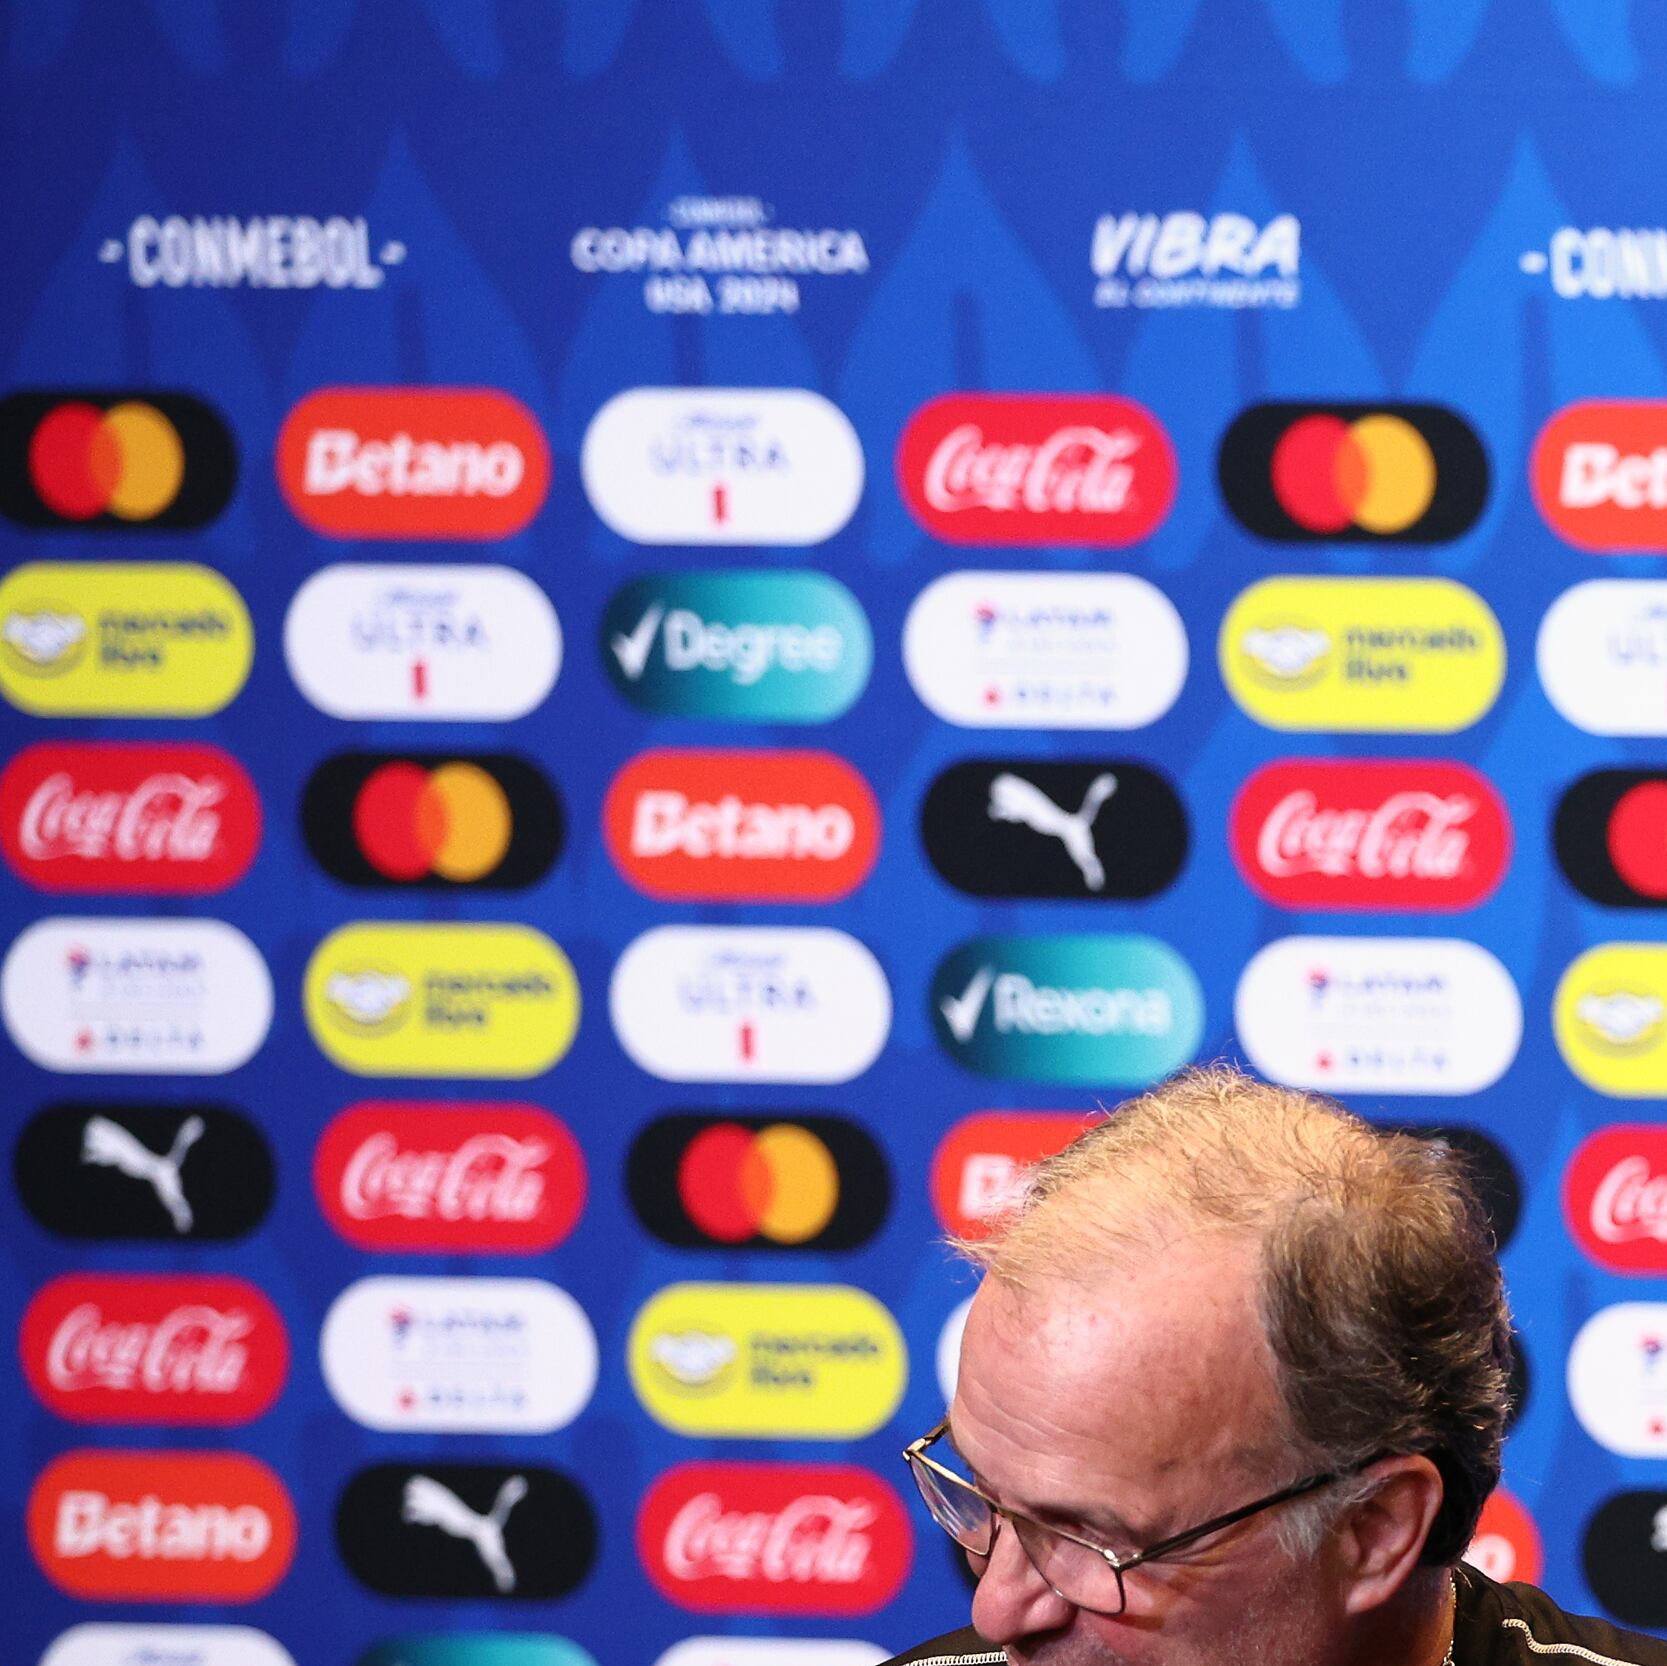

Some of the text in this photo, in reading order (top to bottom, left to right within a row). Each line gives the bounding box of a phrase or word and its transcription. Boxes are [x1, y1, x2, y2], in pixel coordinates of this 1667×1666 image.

[128, 216, 384, 288] CONMEBOL
[571, 227, 869, 274] COPA AMERICA
[1091, 212, 1301, 276] VIBRA
[305, 430, 523, 496] Betano
[664, 611, 834, 683] Degree
[633, 792, 853, 859] Betano
[995, 978, 1165, 1032] Rexona
[56, 1492, 270, 1559] Betano
